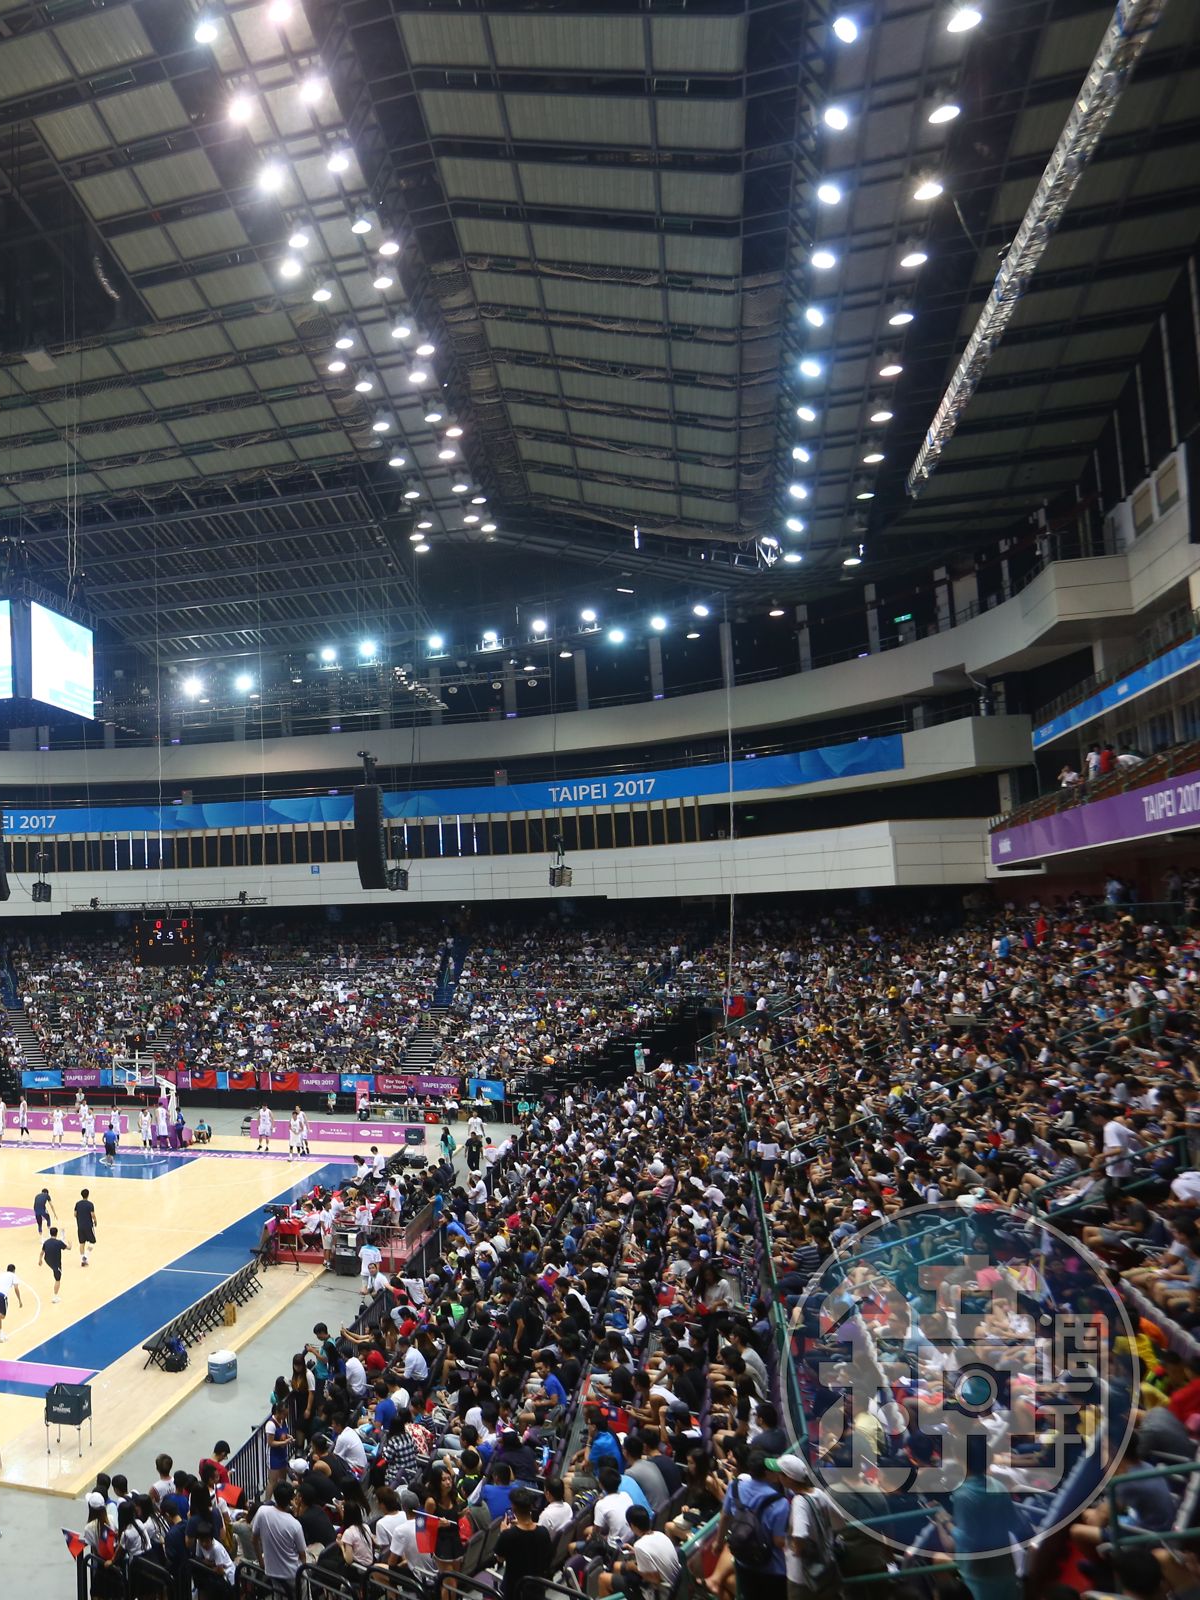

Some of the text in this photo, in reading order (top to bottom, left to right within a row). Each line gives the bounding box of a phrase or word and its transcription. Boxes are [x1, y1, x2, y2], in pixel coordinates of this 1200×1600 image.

[548, 778, 656, 802] TAIPEI 2017
[1142, 789, 1177, 822] TAIPEI
[19, 815, 57, 829] 2017
[66, 1074, 83, 1082] TAIPEI
